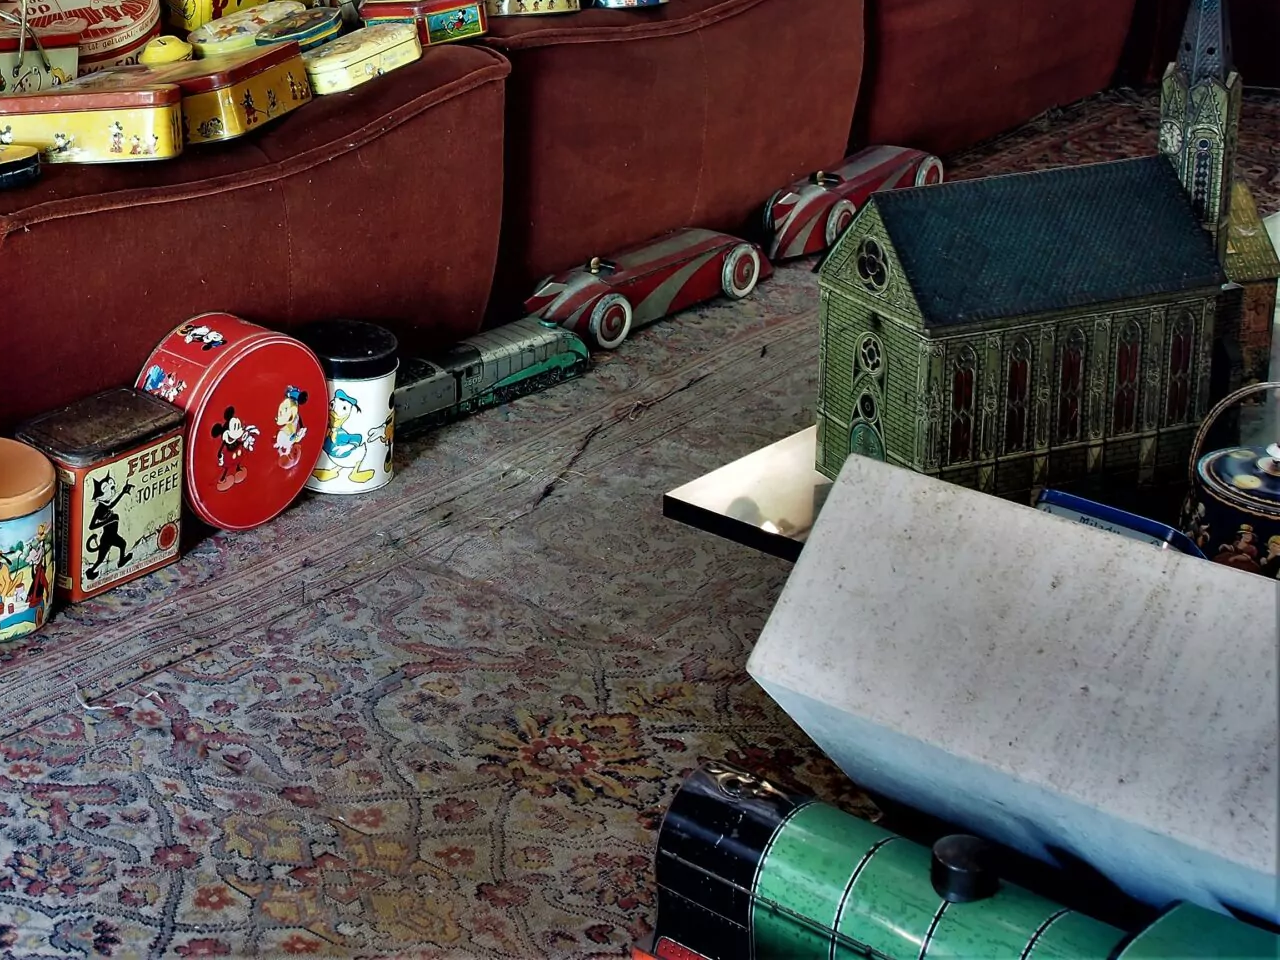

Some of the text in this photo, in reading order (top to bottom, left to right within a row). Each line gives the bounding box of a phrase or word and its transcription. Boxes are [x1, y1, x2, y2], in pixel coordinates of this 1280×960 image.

[127, 439, 181, 478] FELIX
[141, 460, 179, 484] CREAM
[137, 472, 179, 504] TOFFEE
